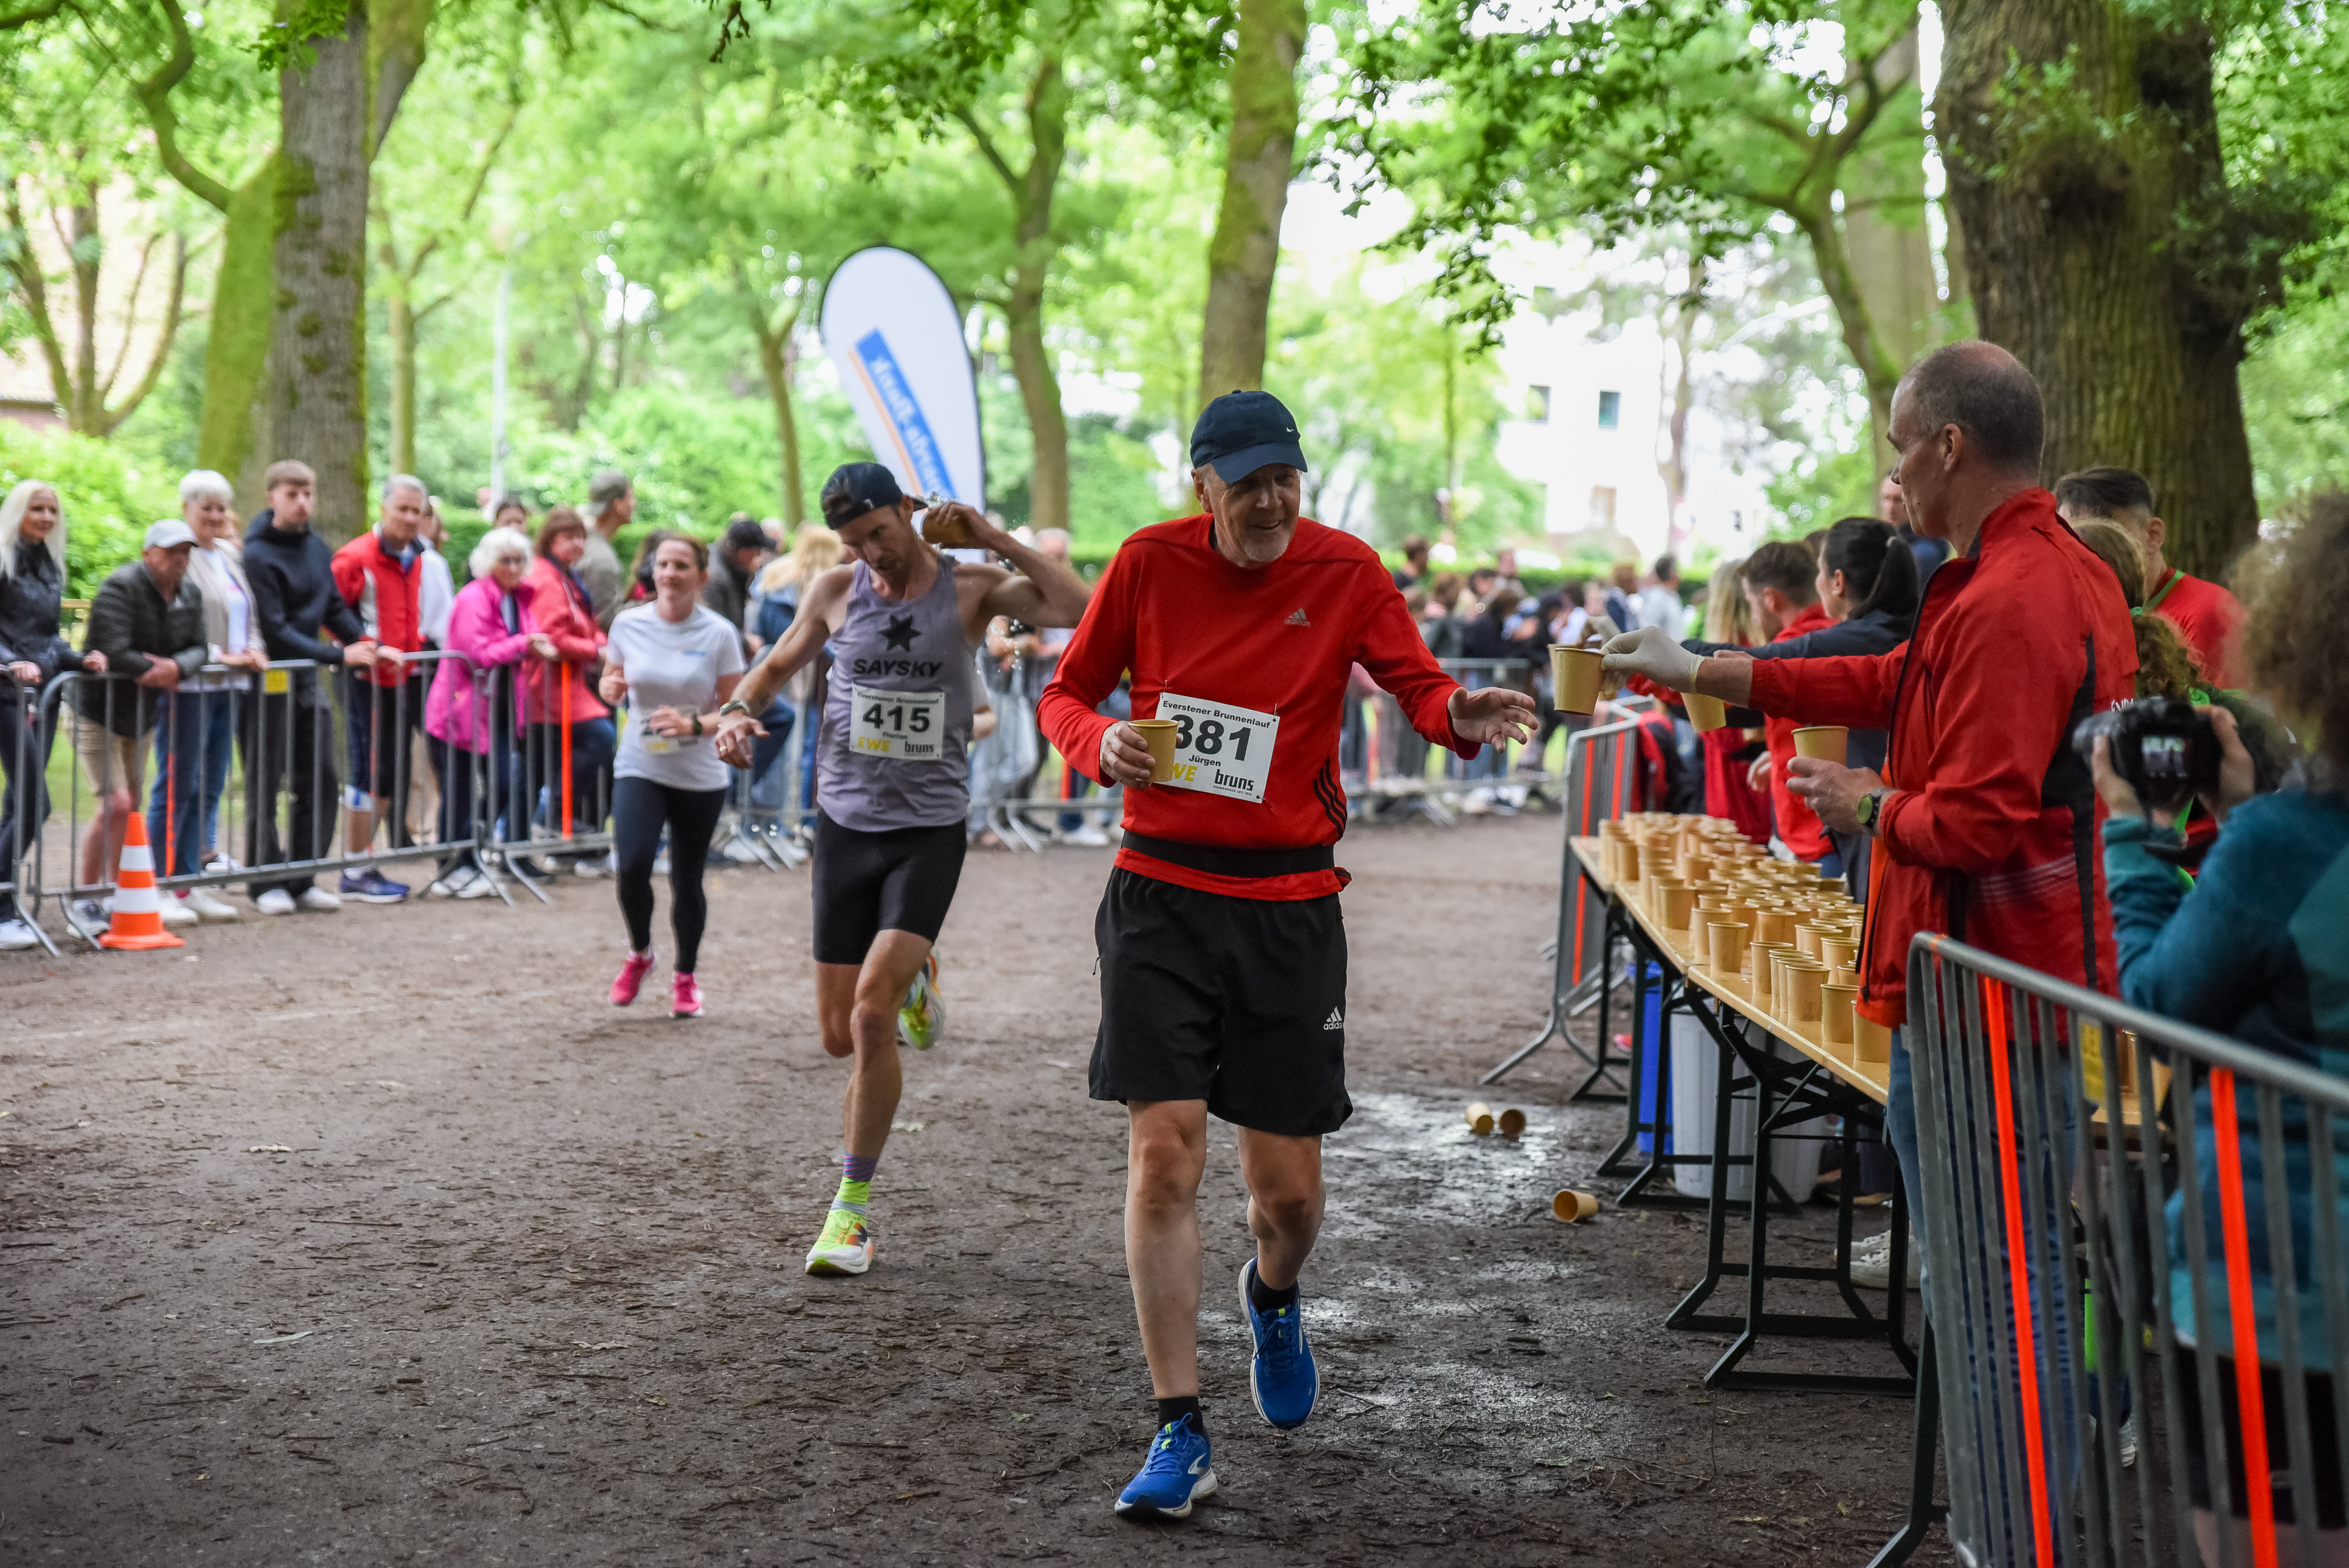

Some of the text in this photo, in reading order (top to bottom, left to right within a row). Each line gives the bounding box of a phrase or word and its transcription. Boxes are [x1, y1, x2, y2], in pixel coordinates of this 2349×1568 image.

[853, 658, 943, 677] SAYSKY
[862, 703, 930, 733] 415
[1162, 700, 1271, 729] Everstener Brunnenlauf
[858, 737, 891, 752] EWE
[904, 741, 934, 753] bruns
[1170, 714, 1252, 762] 381
[1189, 755, 1221, 767] Jürgen
[1214, 769, 1254, 791] bruns
